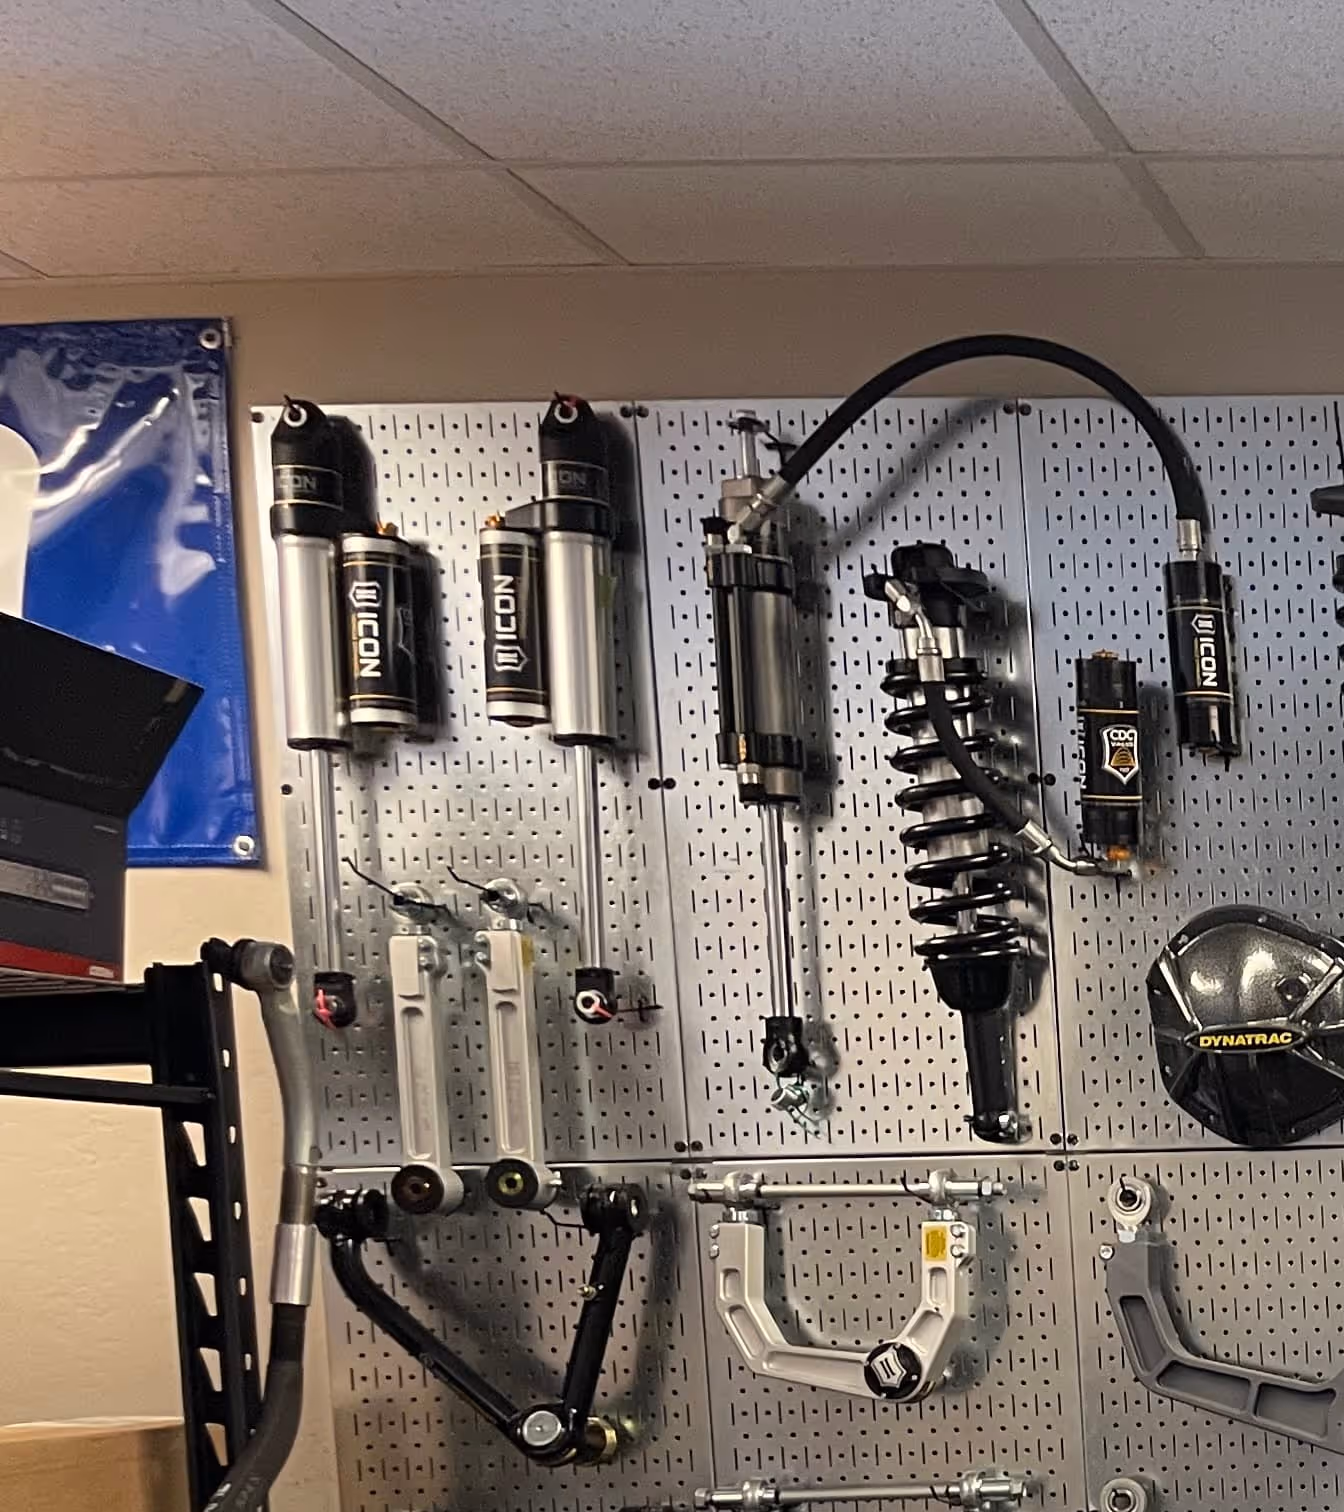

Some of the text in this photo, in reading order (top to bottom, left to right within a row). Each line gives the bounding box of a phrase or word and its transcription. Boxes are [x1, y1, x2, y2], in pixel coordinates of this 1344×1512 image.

[494, 575, 516, 640] ICON
[359, 613, 381, 678] ICON
[1200, 637, 1218, 688] ICON
[1110, 729, 1134, 741] CDC
[1199, 1032, 1292, 1049] DYNATRAC
